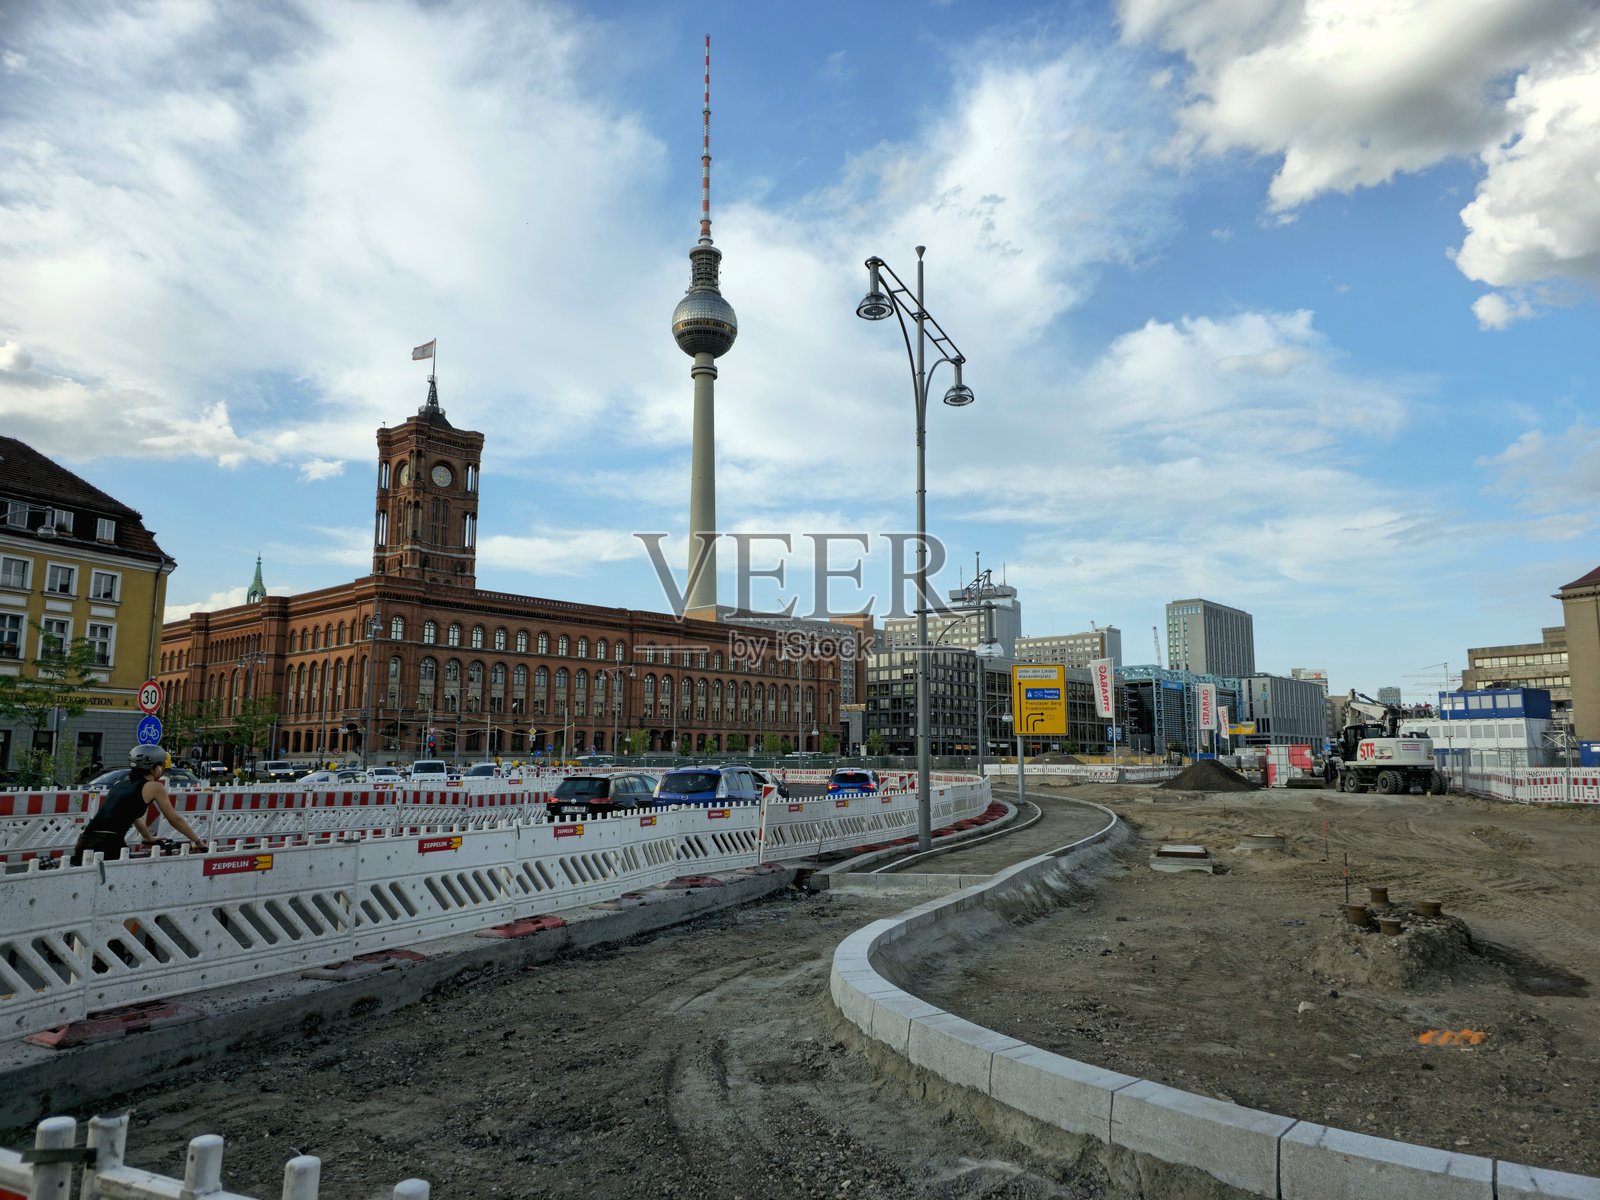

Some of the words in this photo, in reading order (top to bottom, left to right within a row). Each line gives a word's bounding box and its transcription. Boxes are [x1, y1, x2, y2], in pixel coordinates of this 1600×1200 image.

[57, 695, 113, 706] DEKORATION
[142, 690, 158, 705] 30
[1202, 689, 1210, 726] STRABAG
[423, 840, 448, 849] ZEPPELIN
[211, 860, 249, 871] ZEPPELIN
